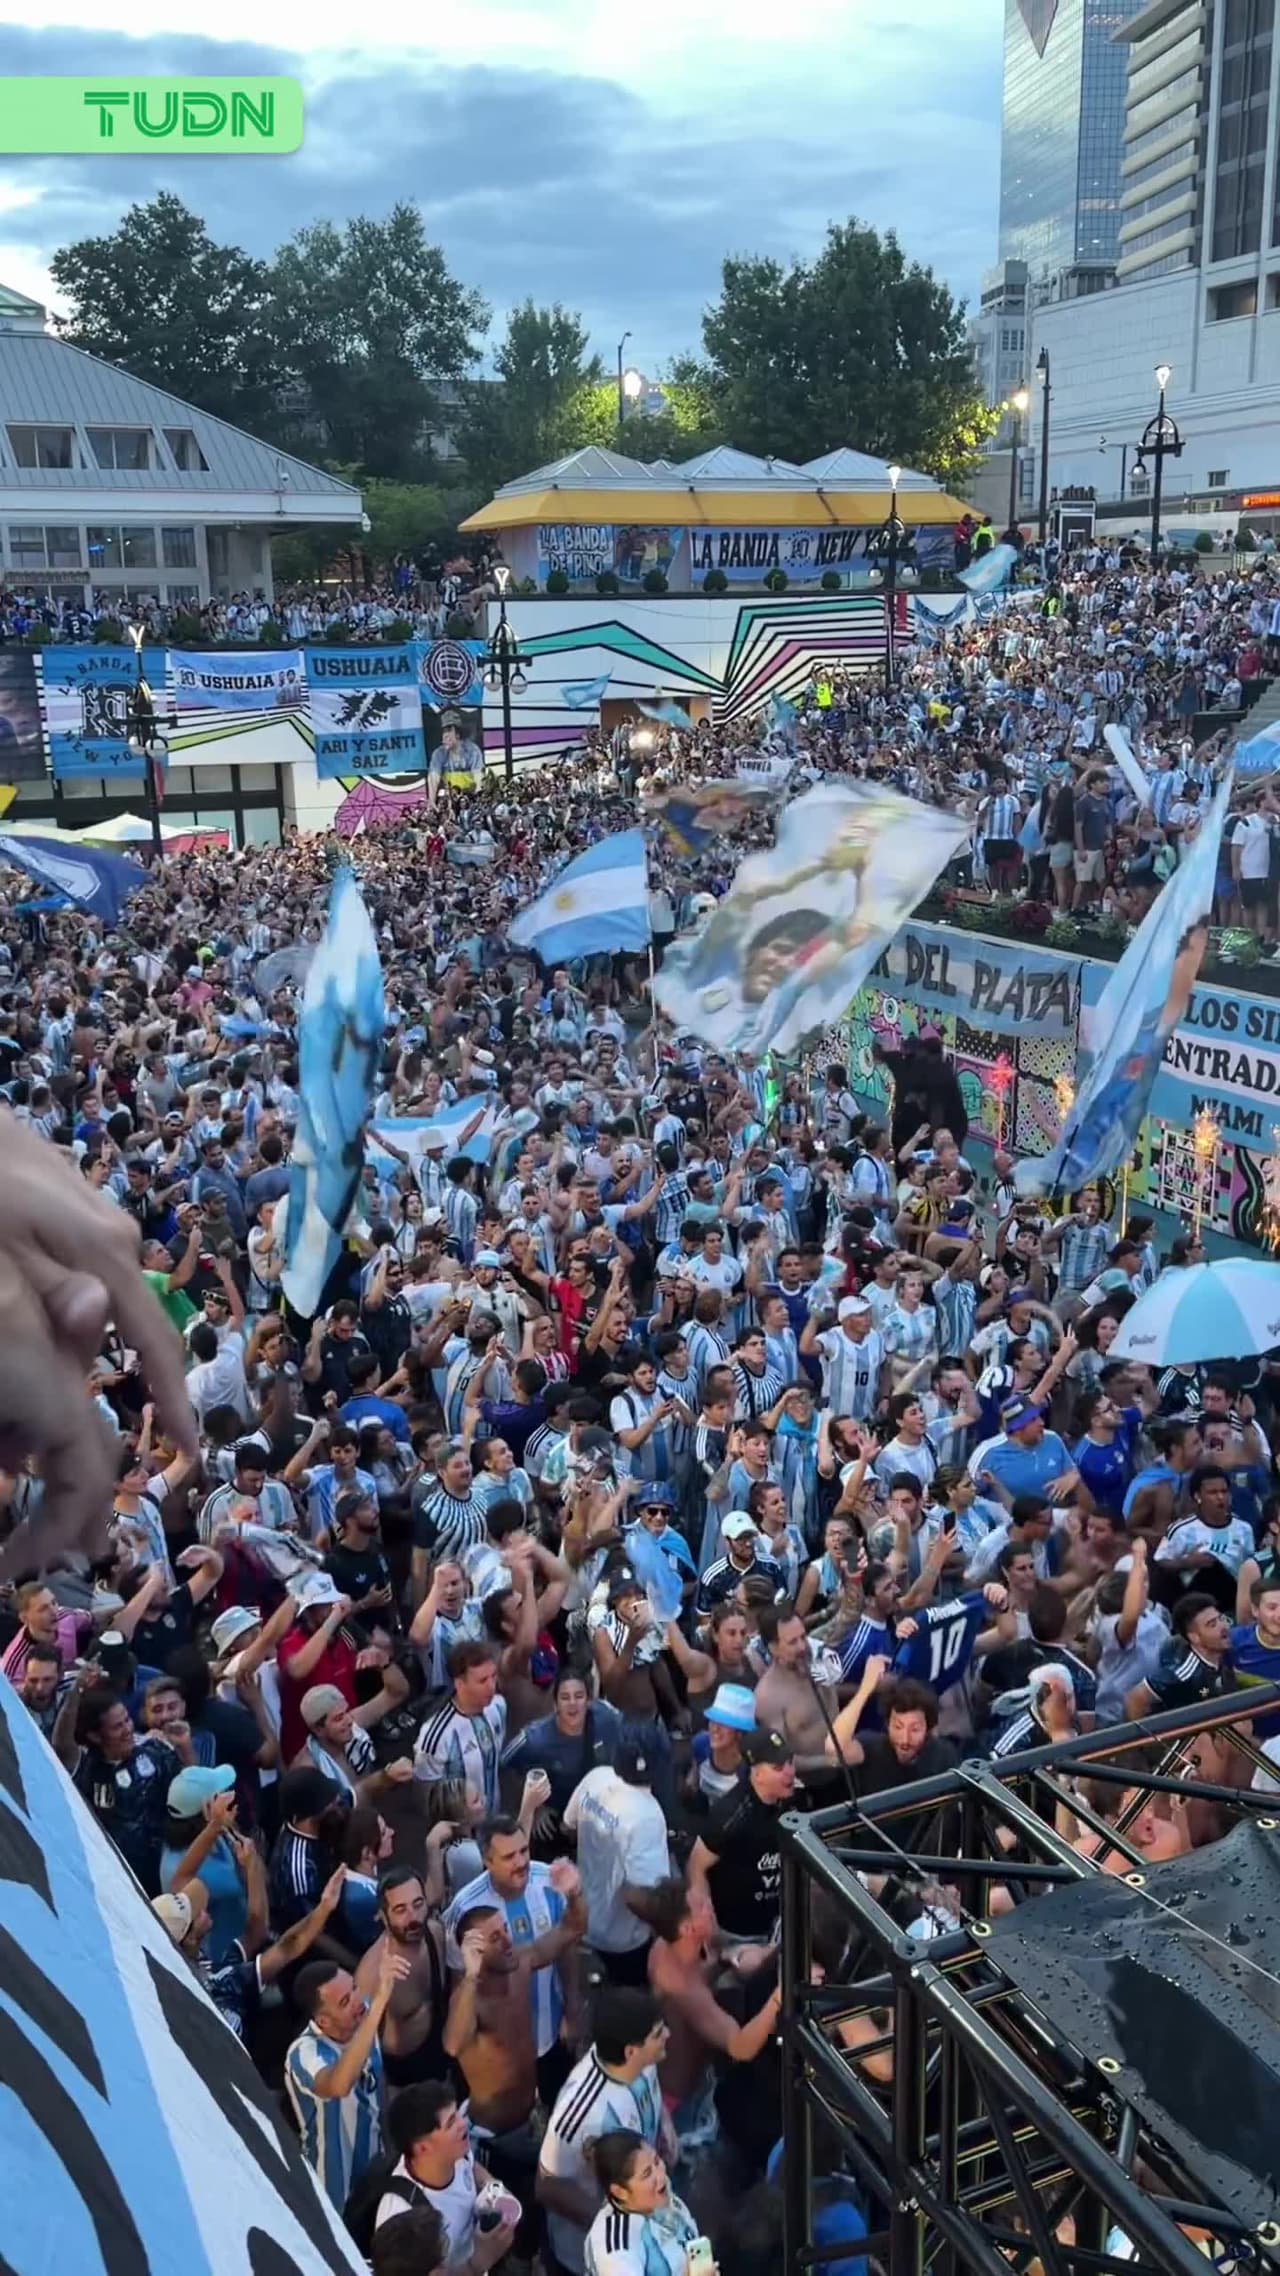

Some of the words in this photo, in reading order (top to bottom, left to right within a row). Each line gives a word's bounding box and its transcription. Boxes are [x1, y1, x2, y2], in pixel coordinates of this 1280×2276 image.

[540, 525, 560, 550] LA
[564, 525, 612, 550] BANDA
[691, 532, 714, 568] LA
[718, 532, 780, 568] BANDA
[814, 529, 860, 566] NEW
[57, 675, 77, 696] LA
[77, 657, 133, 674] BANDA
[200, 674, 275, 690] USHUAIA
[312, 655, 412, 677] USHUAIA
[321, 738, 347, 754] ARI
[352, 737, 363, 752] Y
[369, 734, 417, 750] SANTI
[351, 754, 389, 769] SAIZ
[905, 935, 957, 997] DEL
[969, 959, 1072, 1027] PLATA
[1184, 992, 1241, 1032] LOS
[1245, 1005, 1280, 1044] SI
[1162, 1035, 1280, 1098] ENTRAD
[855, 1371, 869, 1386] 10
[929, 1616, 968, 1683] 10
